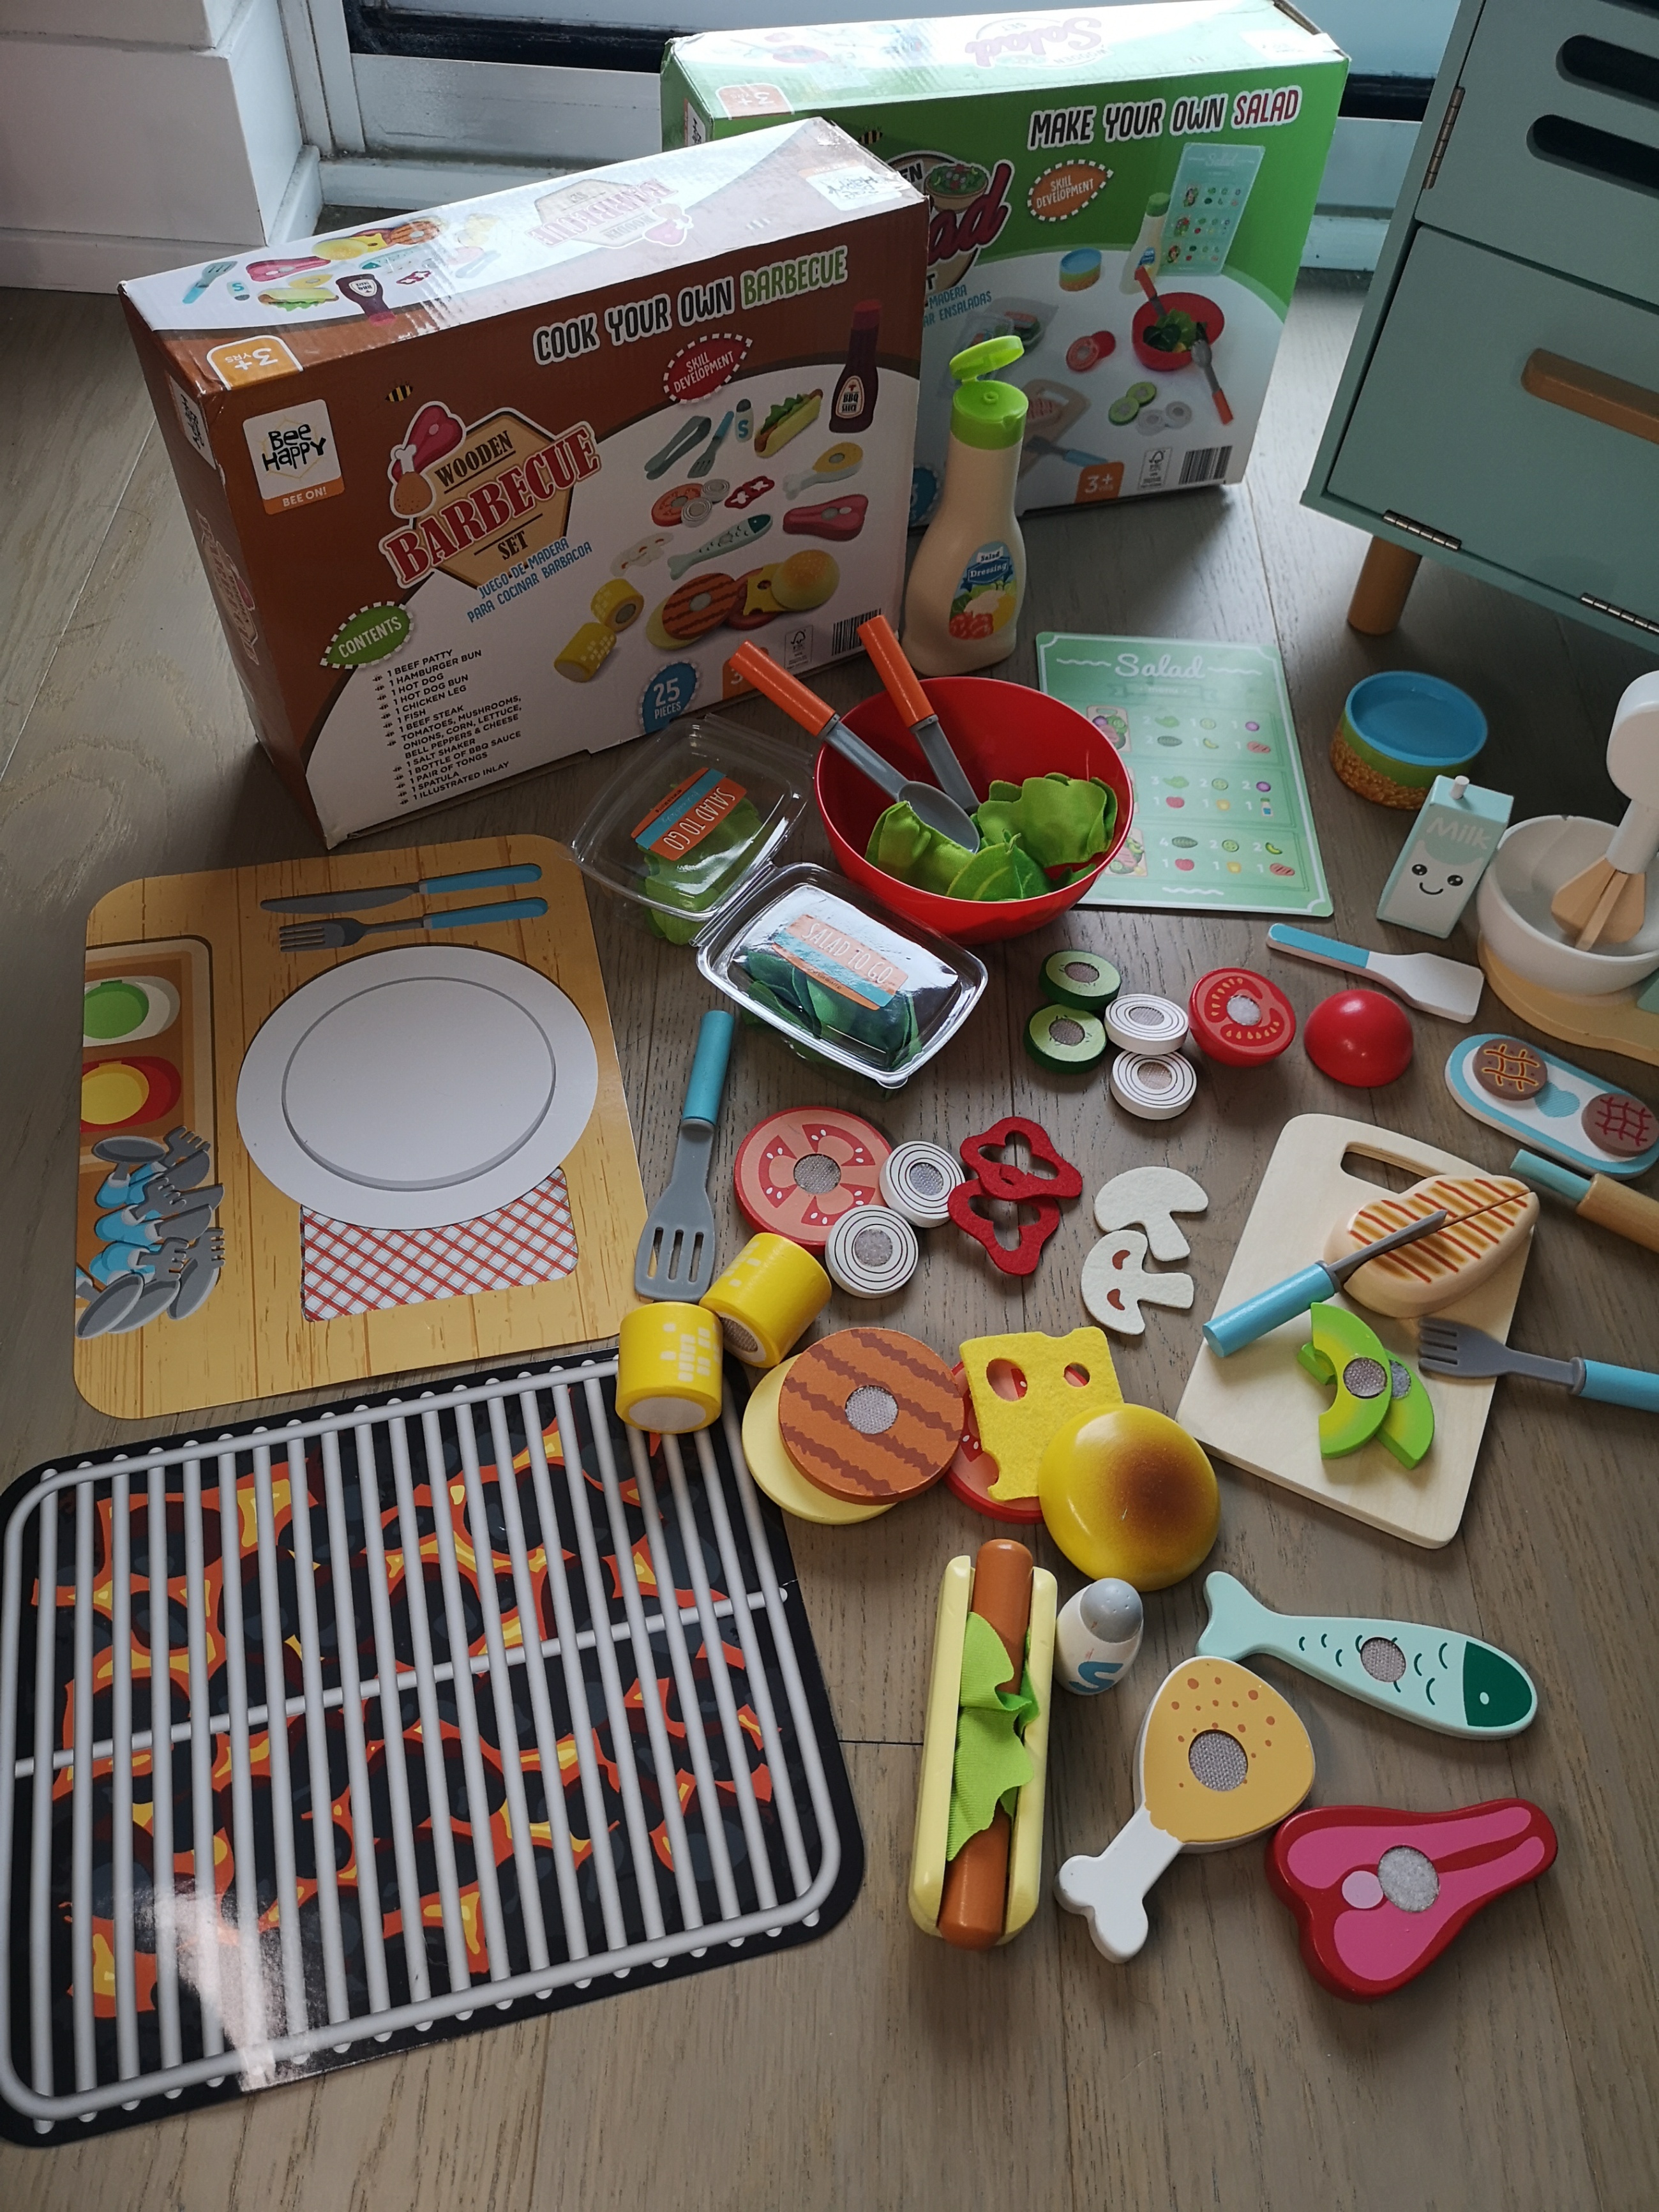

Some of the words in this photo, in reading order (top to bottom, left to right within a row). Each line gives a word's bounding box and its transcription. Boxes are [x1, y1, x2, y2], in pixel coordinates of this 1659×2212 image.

[1029, 108, 1094, 147] MAKE
[1105, 102, 1163, 139] YOUR
[1172, 96, 1226, 133] OWN
[1233, 89, 1300, 126] SALAD
[1036, 178, 1094, 209] DEVELOPMENT
[1050, 174, 1073, 192] SKILL
[536, 317, 598, 363] COOK
[608, 296, 670, 343] YOUR
[680, 279, 733, 324] OWN
[742, 248, 846, 306] BARBECUE
[939, 290, 992, 320] ENSALADAS
[225, 352, 252, 363] YRS
[234, 347, 278, 370] 3+
[673, 350, 735, 394] DEVELOPMENT
[686, 351, 710, 373] SKILL
[843, 392, 859, 403] BBQ
[434, 430, 514, 488] WOODEN
[282, 493, 304, 507] BEE
[305, 486, 327, 500] ON!
[385, 426, 599, 583] BARBECUE
[497, 530, 529, 561] SET
[980, 550, 1000, 562] Salad
[467, 599, 496, 623] PARA
[497, 572, 540, 605] COCINAR
[541, 541, 593, 579] BARBACOA
[479, 573, 509, 599] JUEGO
[511, 562, 527, 579] DE
[527, 538, 569, 569] MADERA
[970, 562, 1008, 578] Dressing
[338, 615, 402, 658] CONTENTS
[394, 660, 420, 675] BEEF
[422, 649, 453, 665] PATTY
[396, 657, 460, 685] HAMBURGER
[461, 649, 482, 663] BUN
[1114, 652, 1206, 679] Salad
[398, 681, 419, 695] HOT
[421, 672, 444, 686] DOG
[400, 690, 421, 703] HOT
[423, 682, 446, 696] DOG
[447, 674, 469, 688] BUN
[402, 692, 446, 713] CHICKEN
[447, 684, 467, 697] LEG
[653, 677, 680, 707] 25
[401, 718, 456, 742] TOMATOES,
[458, 695, 522, 722] MUSHROOMS,
[404, 709, 426, 722] FISH
[406, 716, 431, 731] BEEF
[433, 705, 464, 721] STEAK
[654, 701, 681, 719] PIECES
[403, 732, 445, 751] ONIONS,
[446, 720, 476, 735] CORN,
[478, 704, 522, 724] LETTUCE,
[405, 746, 429, 759] BELL
[431, 730, 472, 750] PEPPERS
[483, 713, 519, 732] CHEESE
[413, 753, 436, 765] SALT
[438, 738, 476, 756] SHAKER
[415, 756, 451, 774] BOTTLE
[453, 750, 467, 760] OF
[469, 742, 490, 754] BBQ
[491, 730, 522, 747] SAUCE
[416, 769, 439, 783] PAIR
[440, 764, 454, 774] OF
[456, 752, 488, 768] TONGS
[418, 771, 460, 791] SPATULA
[419, 772, 481, 799] ILLUSTRATED
[483, 760, 509, 776] INLAY
[694, 786, 736, 822] SALAD
[663, 831, 691, 851] GO
[679, 817, 707, 836] TO
[801, 922, 851, 957] SALAD
[847, 947, 871, 971] TO
[867, 961, 894, 984] GO
[1068, 1661, 1123, 1694] S
